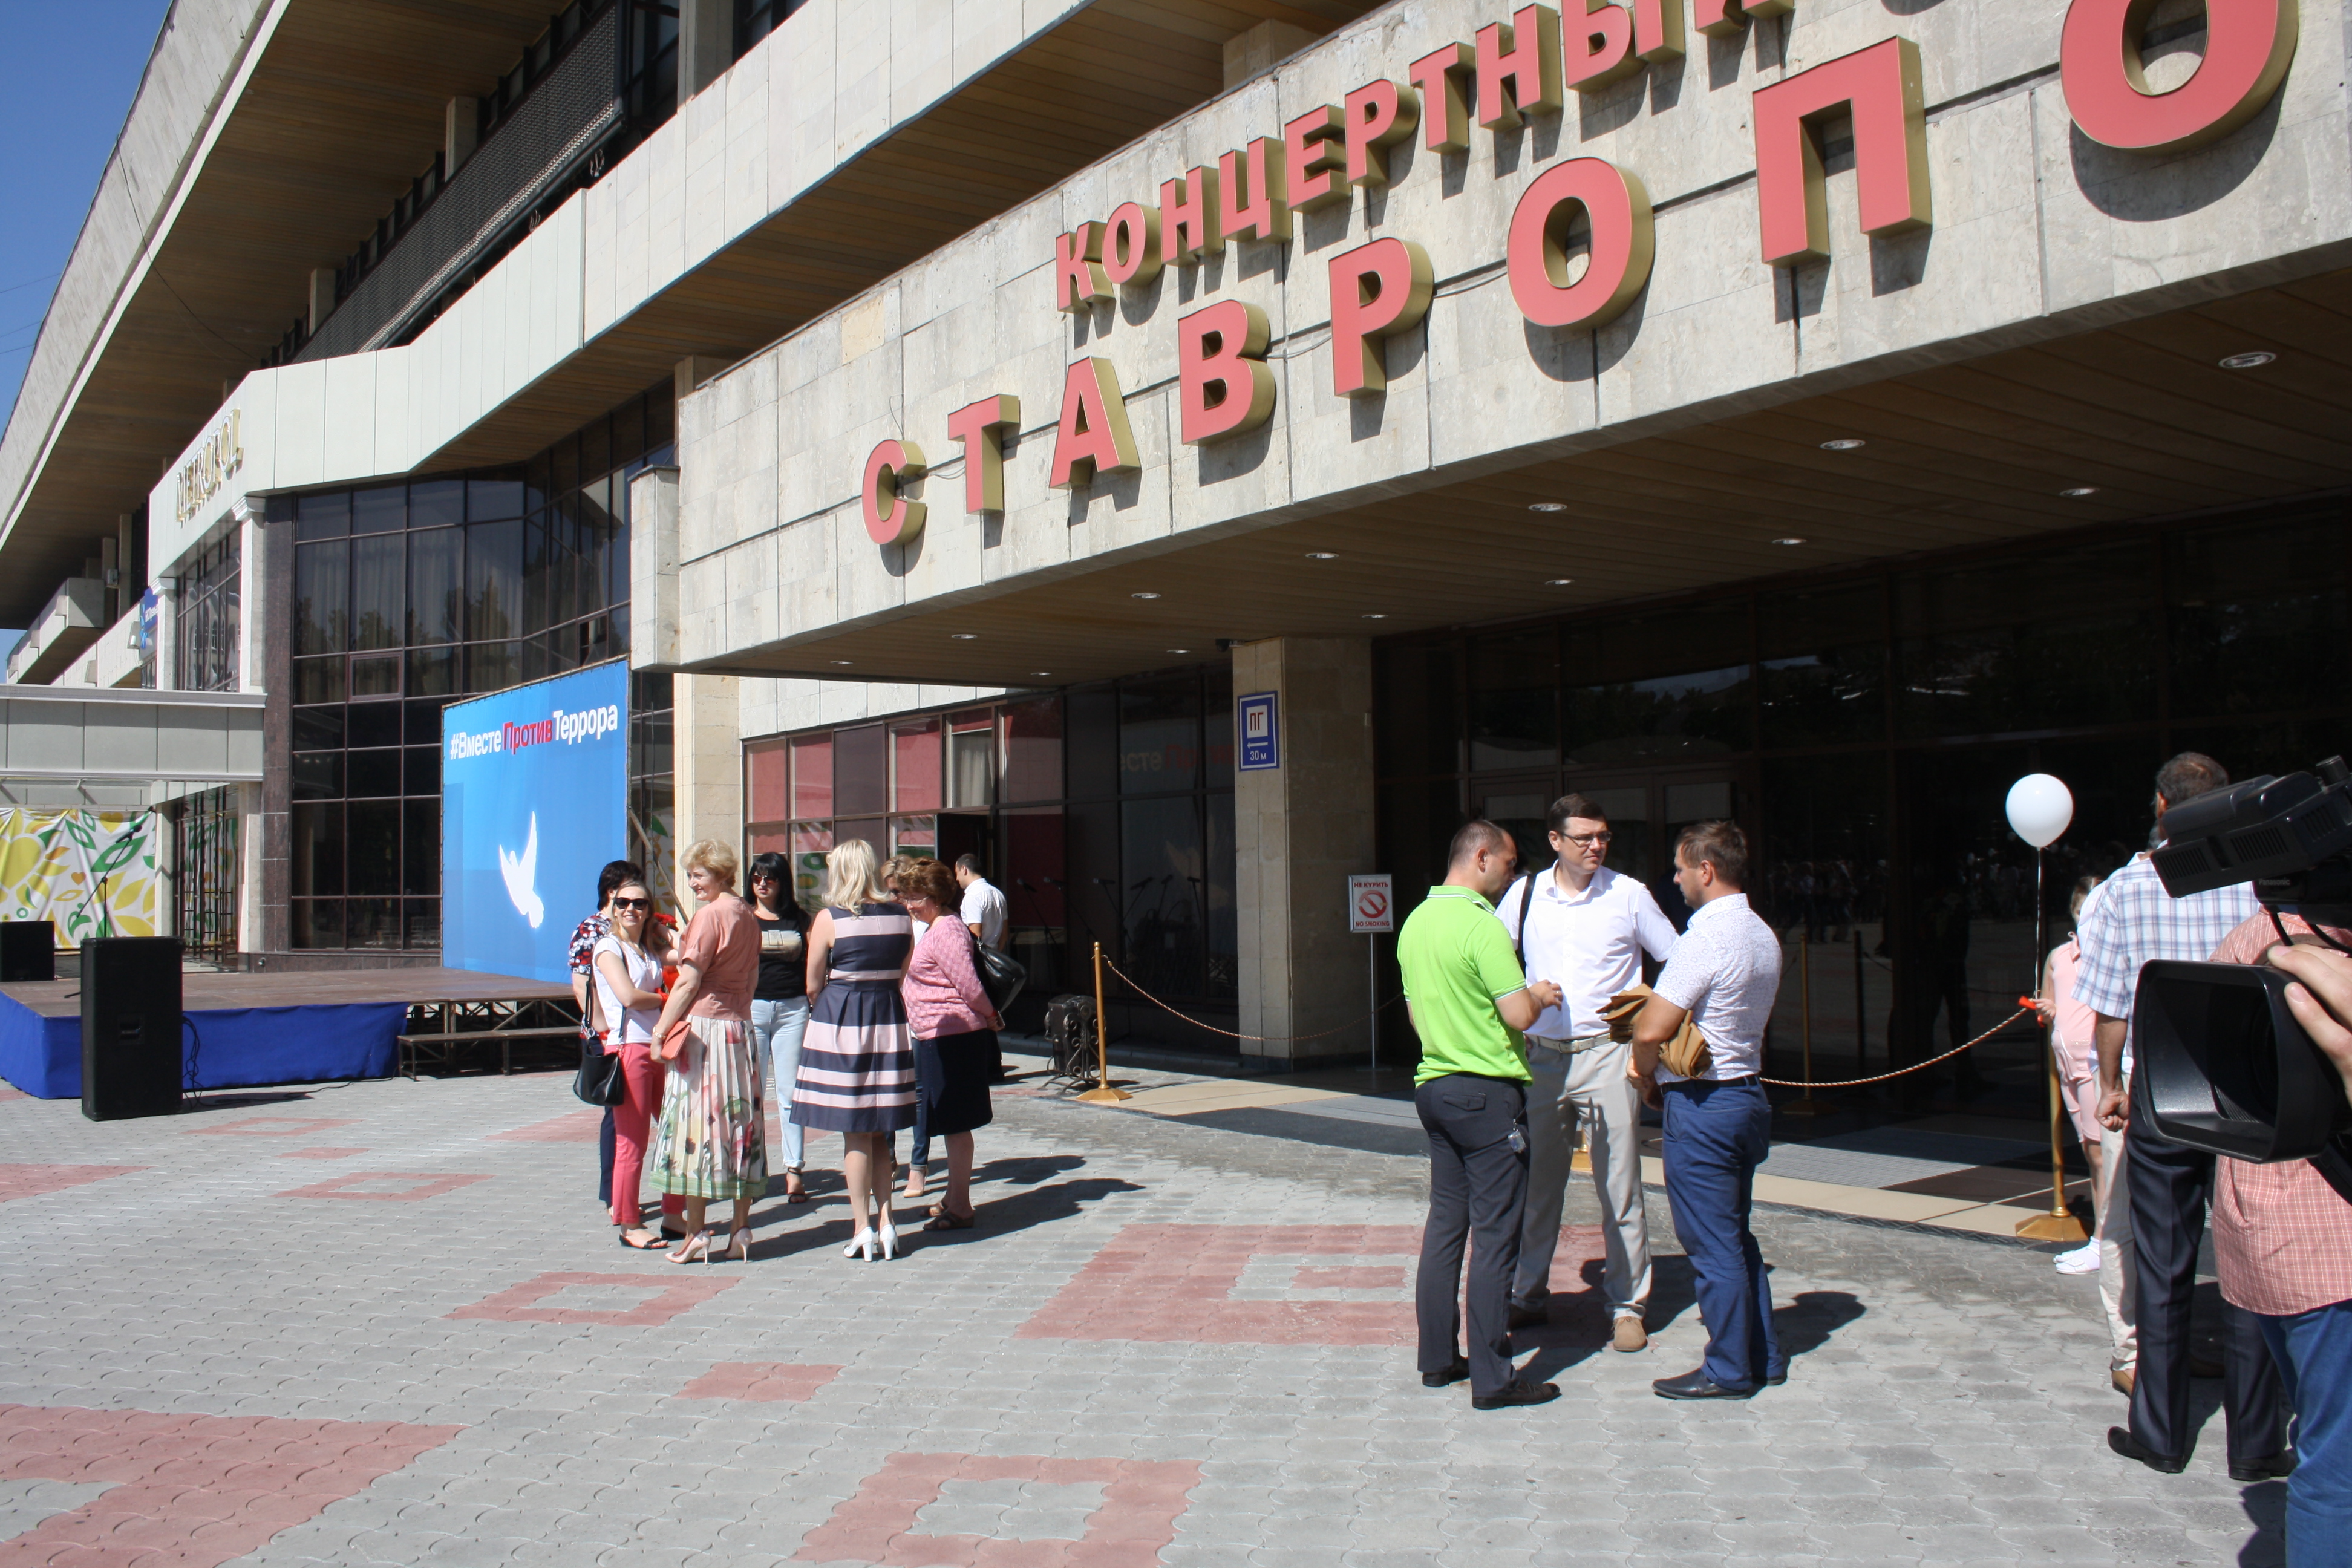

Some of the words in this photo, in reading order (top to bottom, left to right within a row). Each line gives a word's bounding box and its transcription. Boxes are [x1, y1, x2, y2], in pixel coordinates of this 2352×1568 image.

[1056, 0, 1794, 313] КОНЦЕРТНЫ
[1250, 711, 1264, 731] ПГ
[1250, 750, 1259, 761] 30
[2258, 878, 2290, 886] Panasonic
